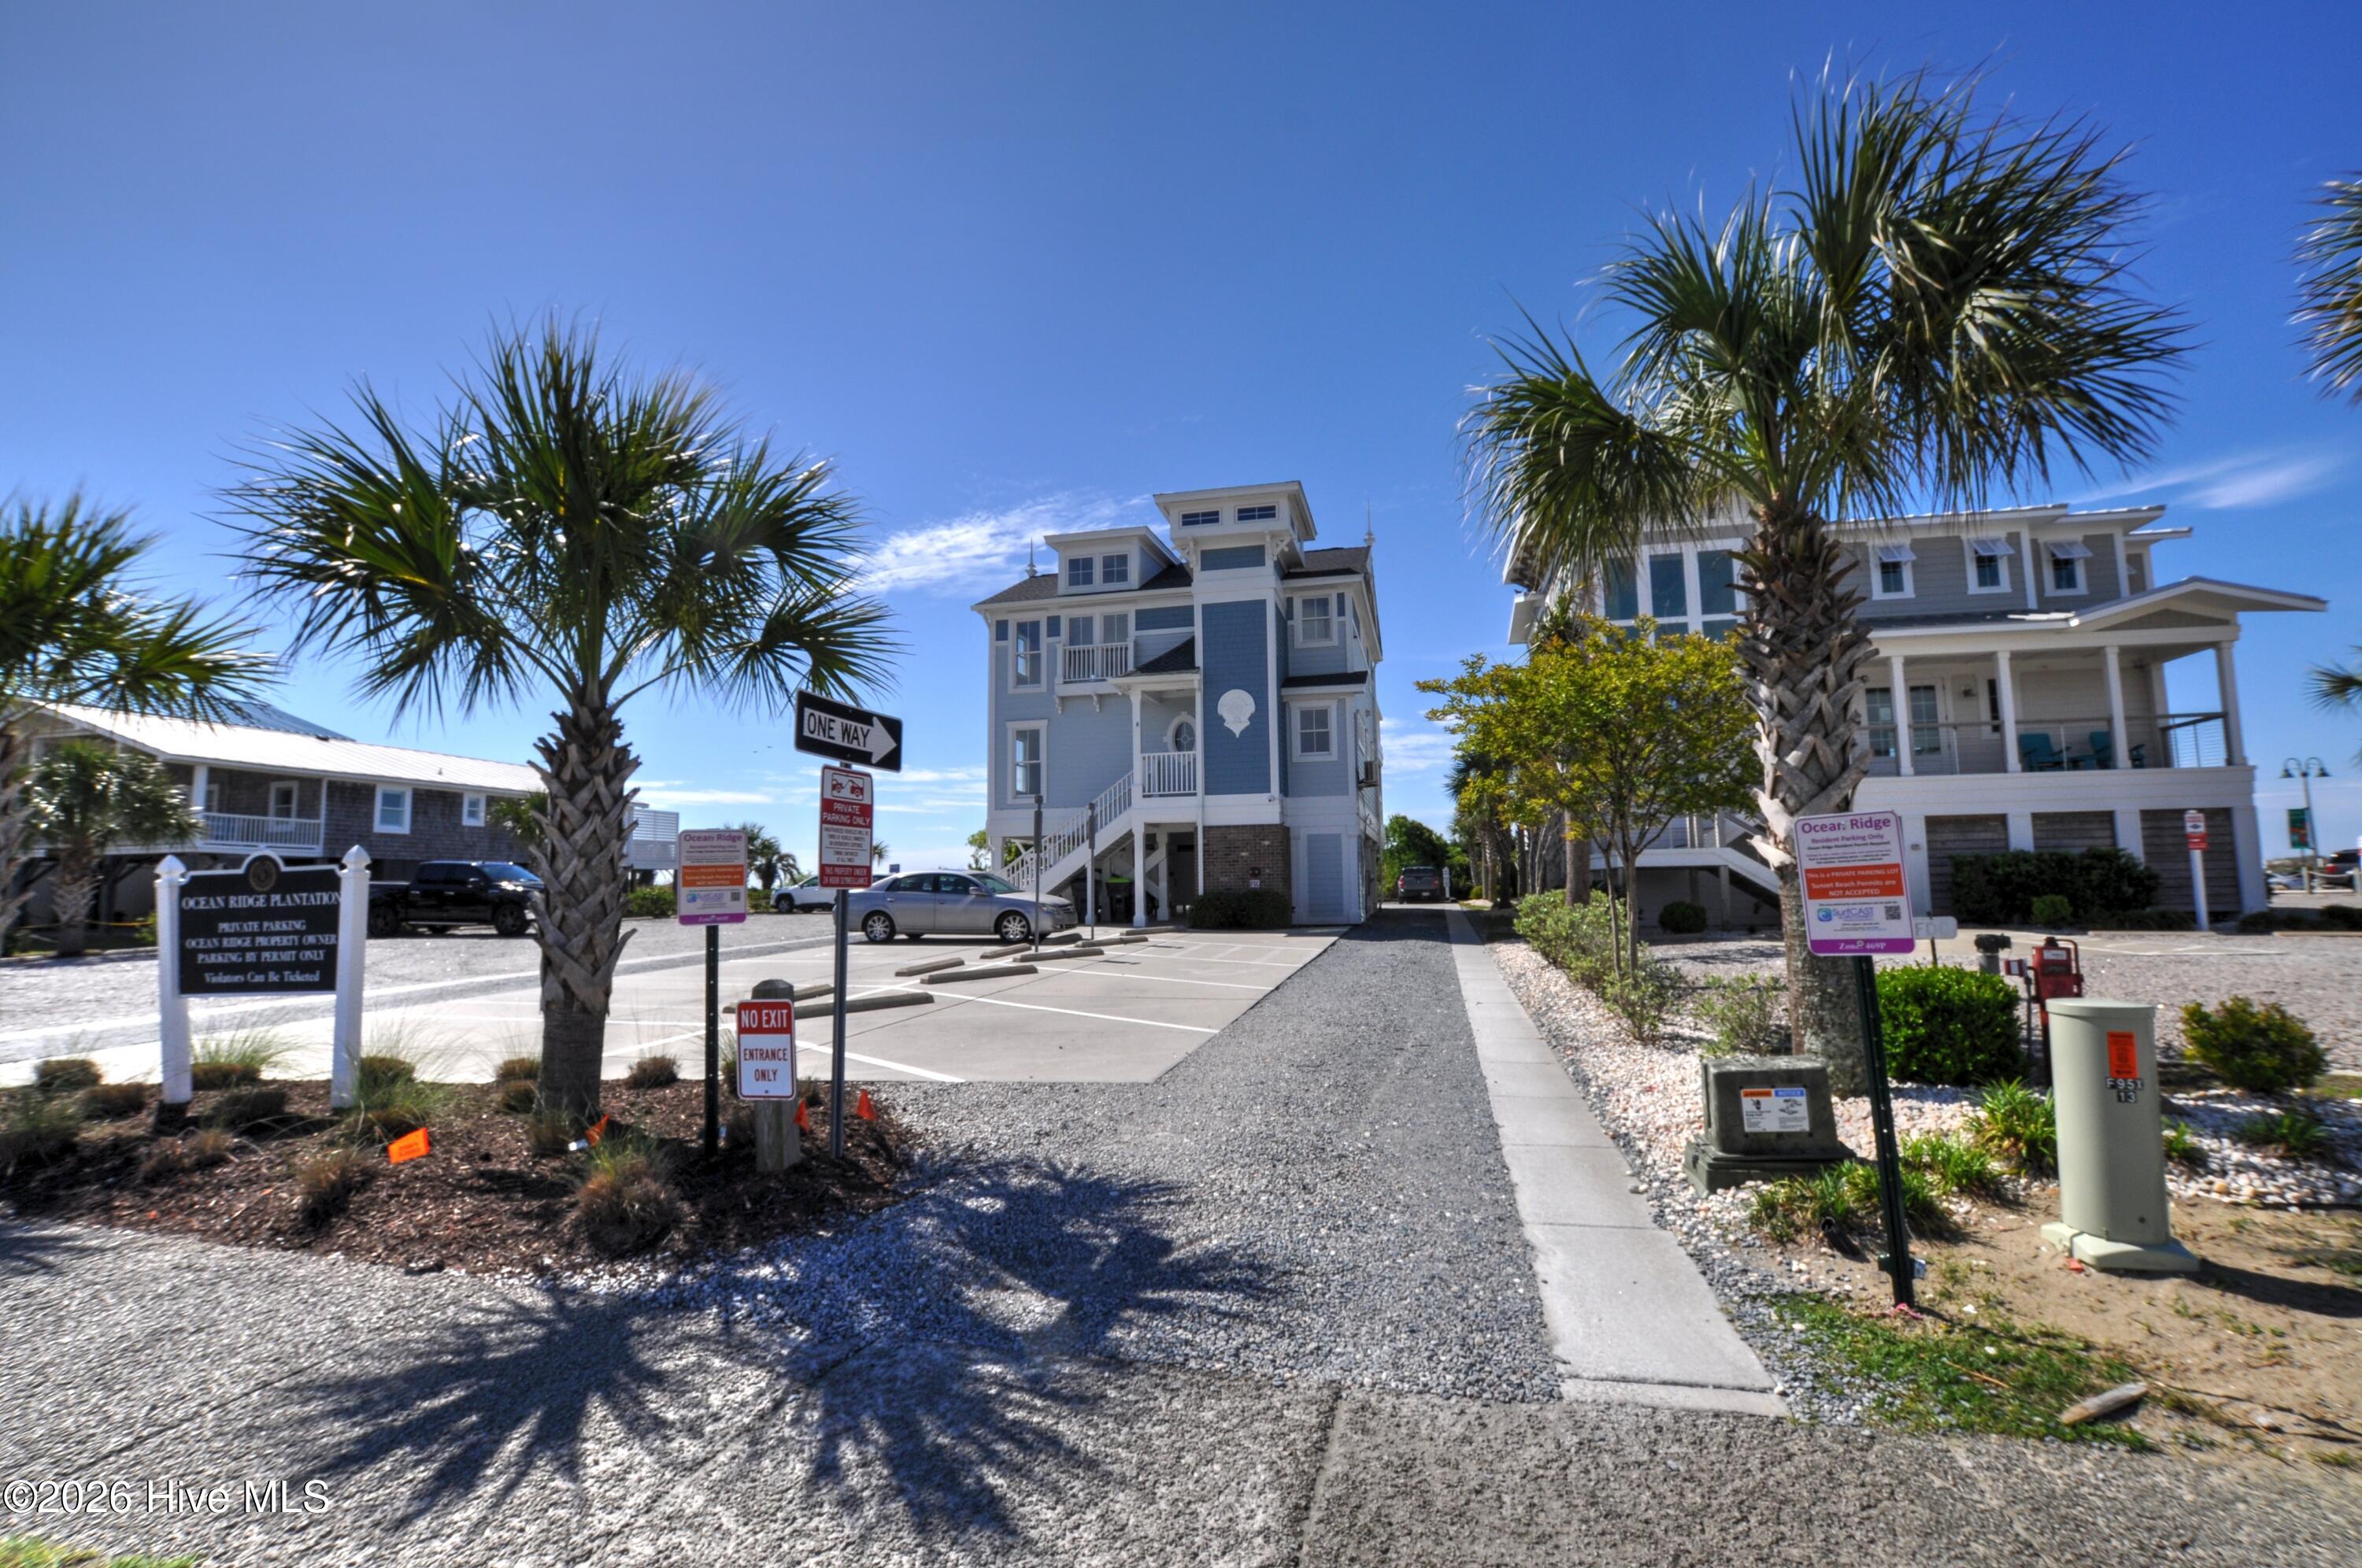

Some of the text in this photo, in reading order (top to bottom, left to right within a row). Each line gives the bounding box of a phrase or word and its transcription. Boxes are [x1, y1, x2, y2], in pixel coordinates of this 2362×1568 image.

[807, 712, 870, 748] ONE WAY
[834, 803, 861, 814] PRIVATE
[823, 812, 871, 826] PARKING ONLY
[1850, 817, 1891, 830] Ridge
[716, 834, 742, 843] Ridge
[182, 892, 341, 909] OCEAN RIDGE PLANTATION
[217, 920, 306, 933] PRIVATE PARKING
[185, 937, 219, 949] OCEAN
[221, 937, 254, 948] RIDGE
[255, 936, 300, 947] PROPERTY
[197, 949, 326, 963] PARKING BY PERMIT ONLY
[203, 970, 320, 983] Violators Can Be Ticketed
[741, 1009, 788, 1028] NO EXIT
[743, 1048, 788, 1061] ENTRANCE
[754, 1069, 778, 1082] ONLY
[2119, 1092, 2136, 1103] 13
